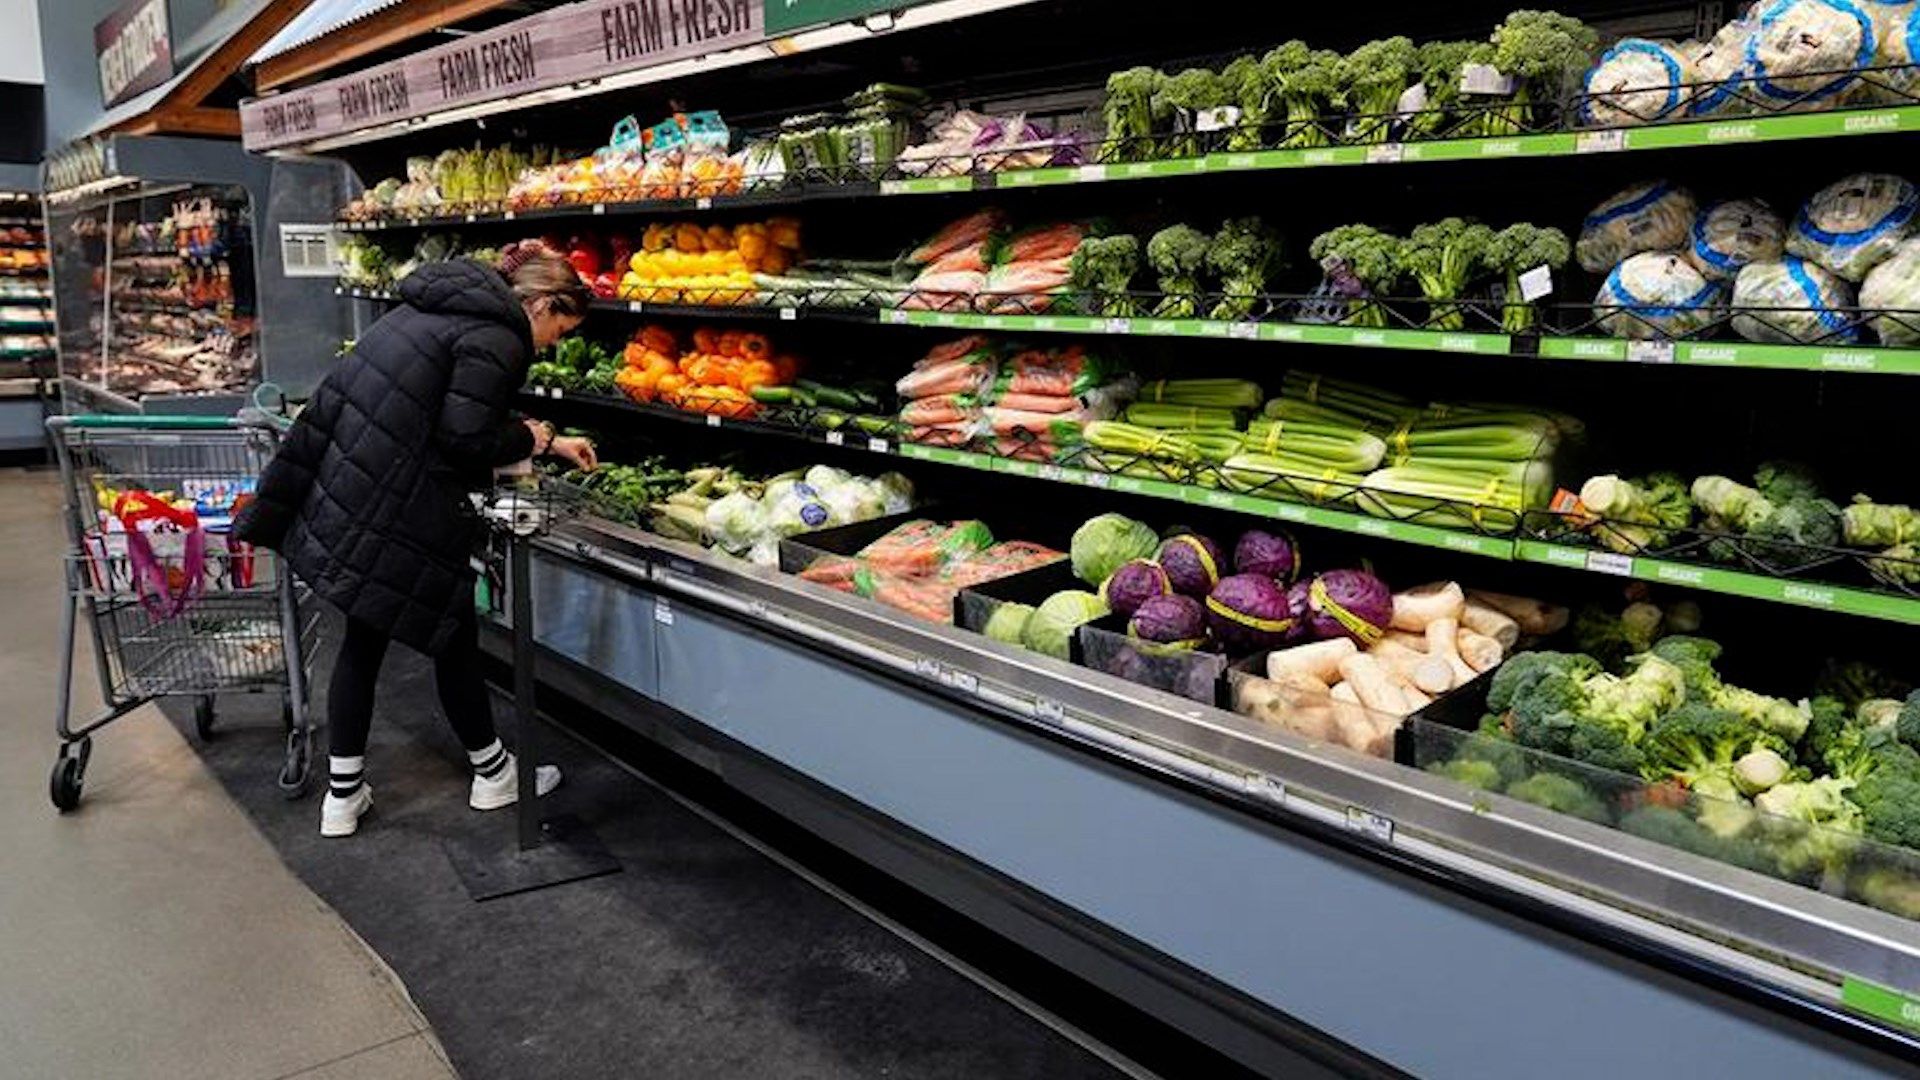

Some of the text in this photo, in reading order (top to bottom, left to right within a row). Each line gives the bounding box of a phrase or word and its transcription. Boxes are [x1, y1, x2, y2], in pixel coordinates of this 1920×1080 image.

[601, 0, 751, 62] FARM FRESH
[439, 31, 536, 99] FARM FRESH
[338, 71, 411, 125] FARM FRESH
[1707, 124, 1756, 141] ORGANIC
[1845, 113, 1899, 131] ORGANIC
[1821, 352, 1876, 367] ORGANIC
[1784, 583, 1834, 605] ORGANIC
